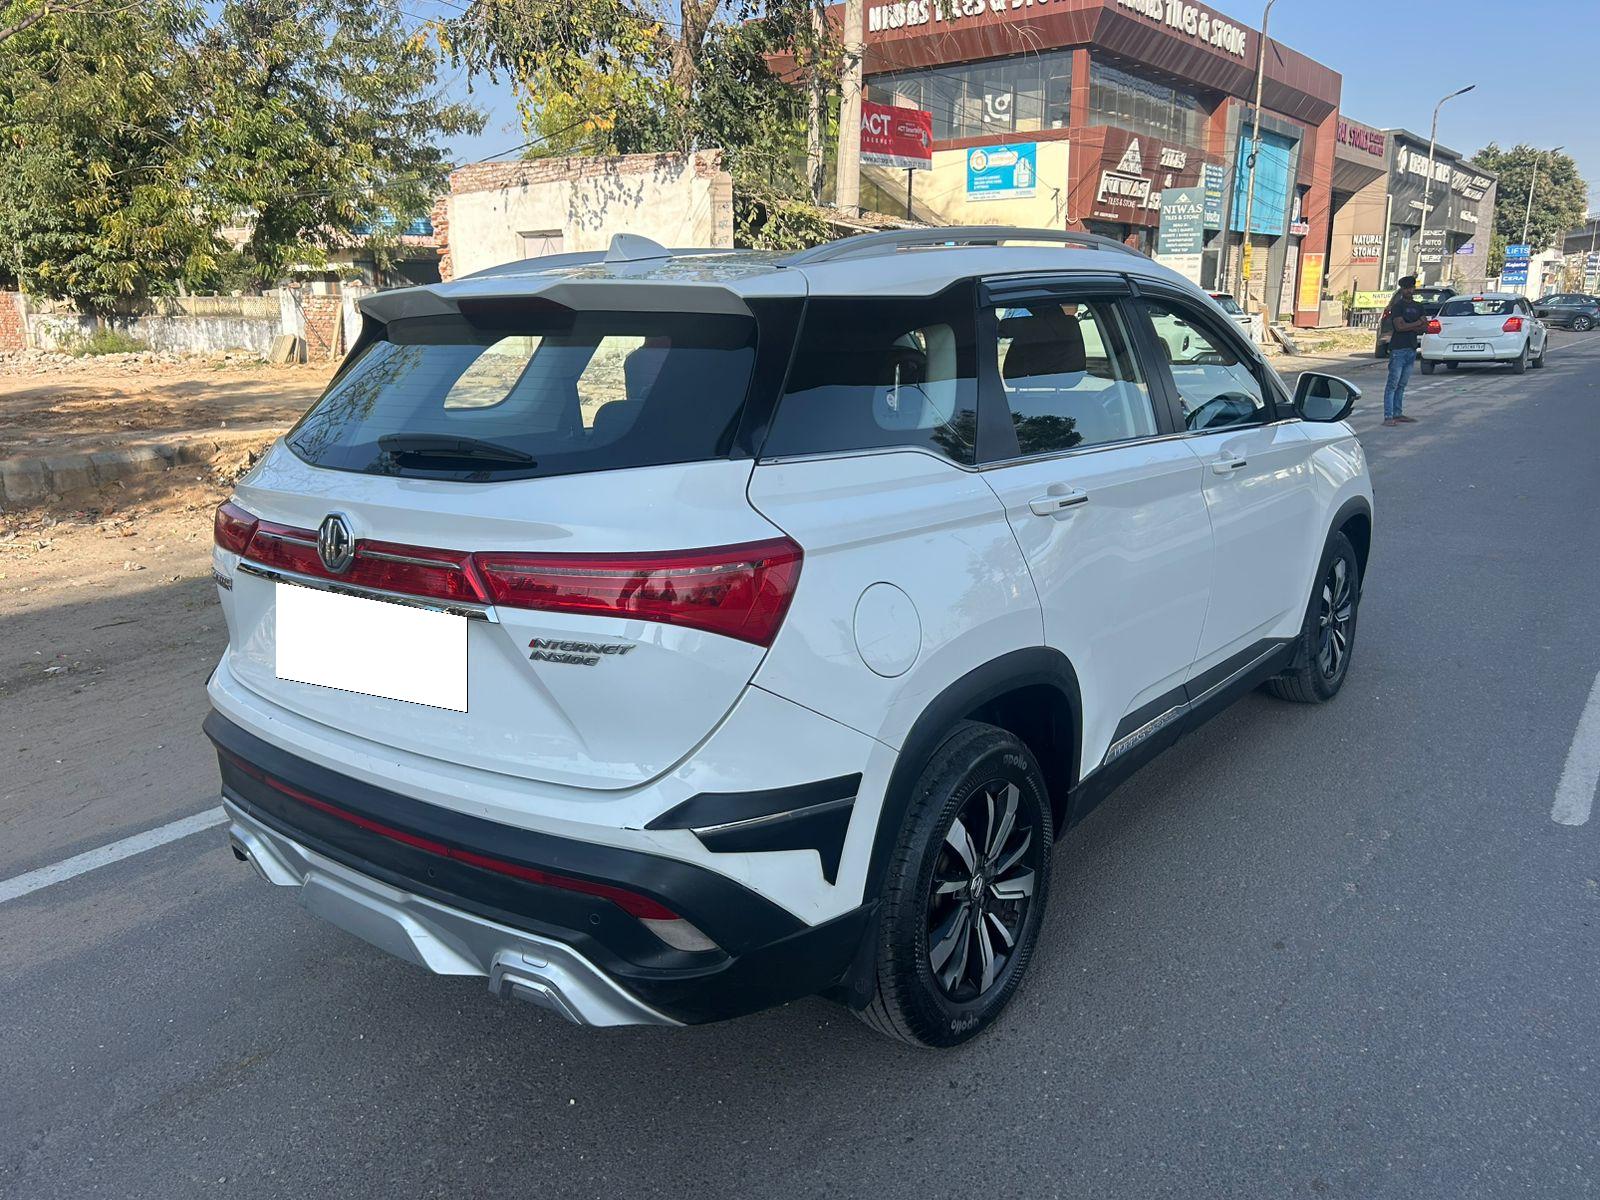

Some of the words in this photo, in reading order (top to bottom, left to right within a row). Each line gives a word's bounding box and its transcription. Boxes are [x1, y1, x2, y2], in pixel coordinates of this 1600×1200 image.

[869, 0, 929, 32] NIWAS
[933, 0, 986, 21] TLES
[1210, 19, 1247, 58] STONE
[861, 111, 891, 137] ACT
[1101, 176, 1148, 198] NIWAS
[1162, 203, 1204, 214] NIWAS
[1352, 234, 1382, 246] NATURAL
[1352, 246, 1381, 258] STONEX
[528, 638, 637, 655] INTERNET
[528, 650, 601, 666] INSIDE
